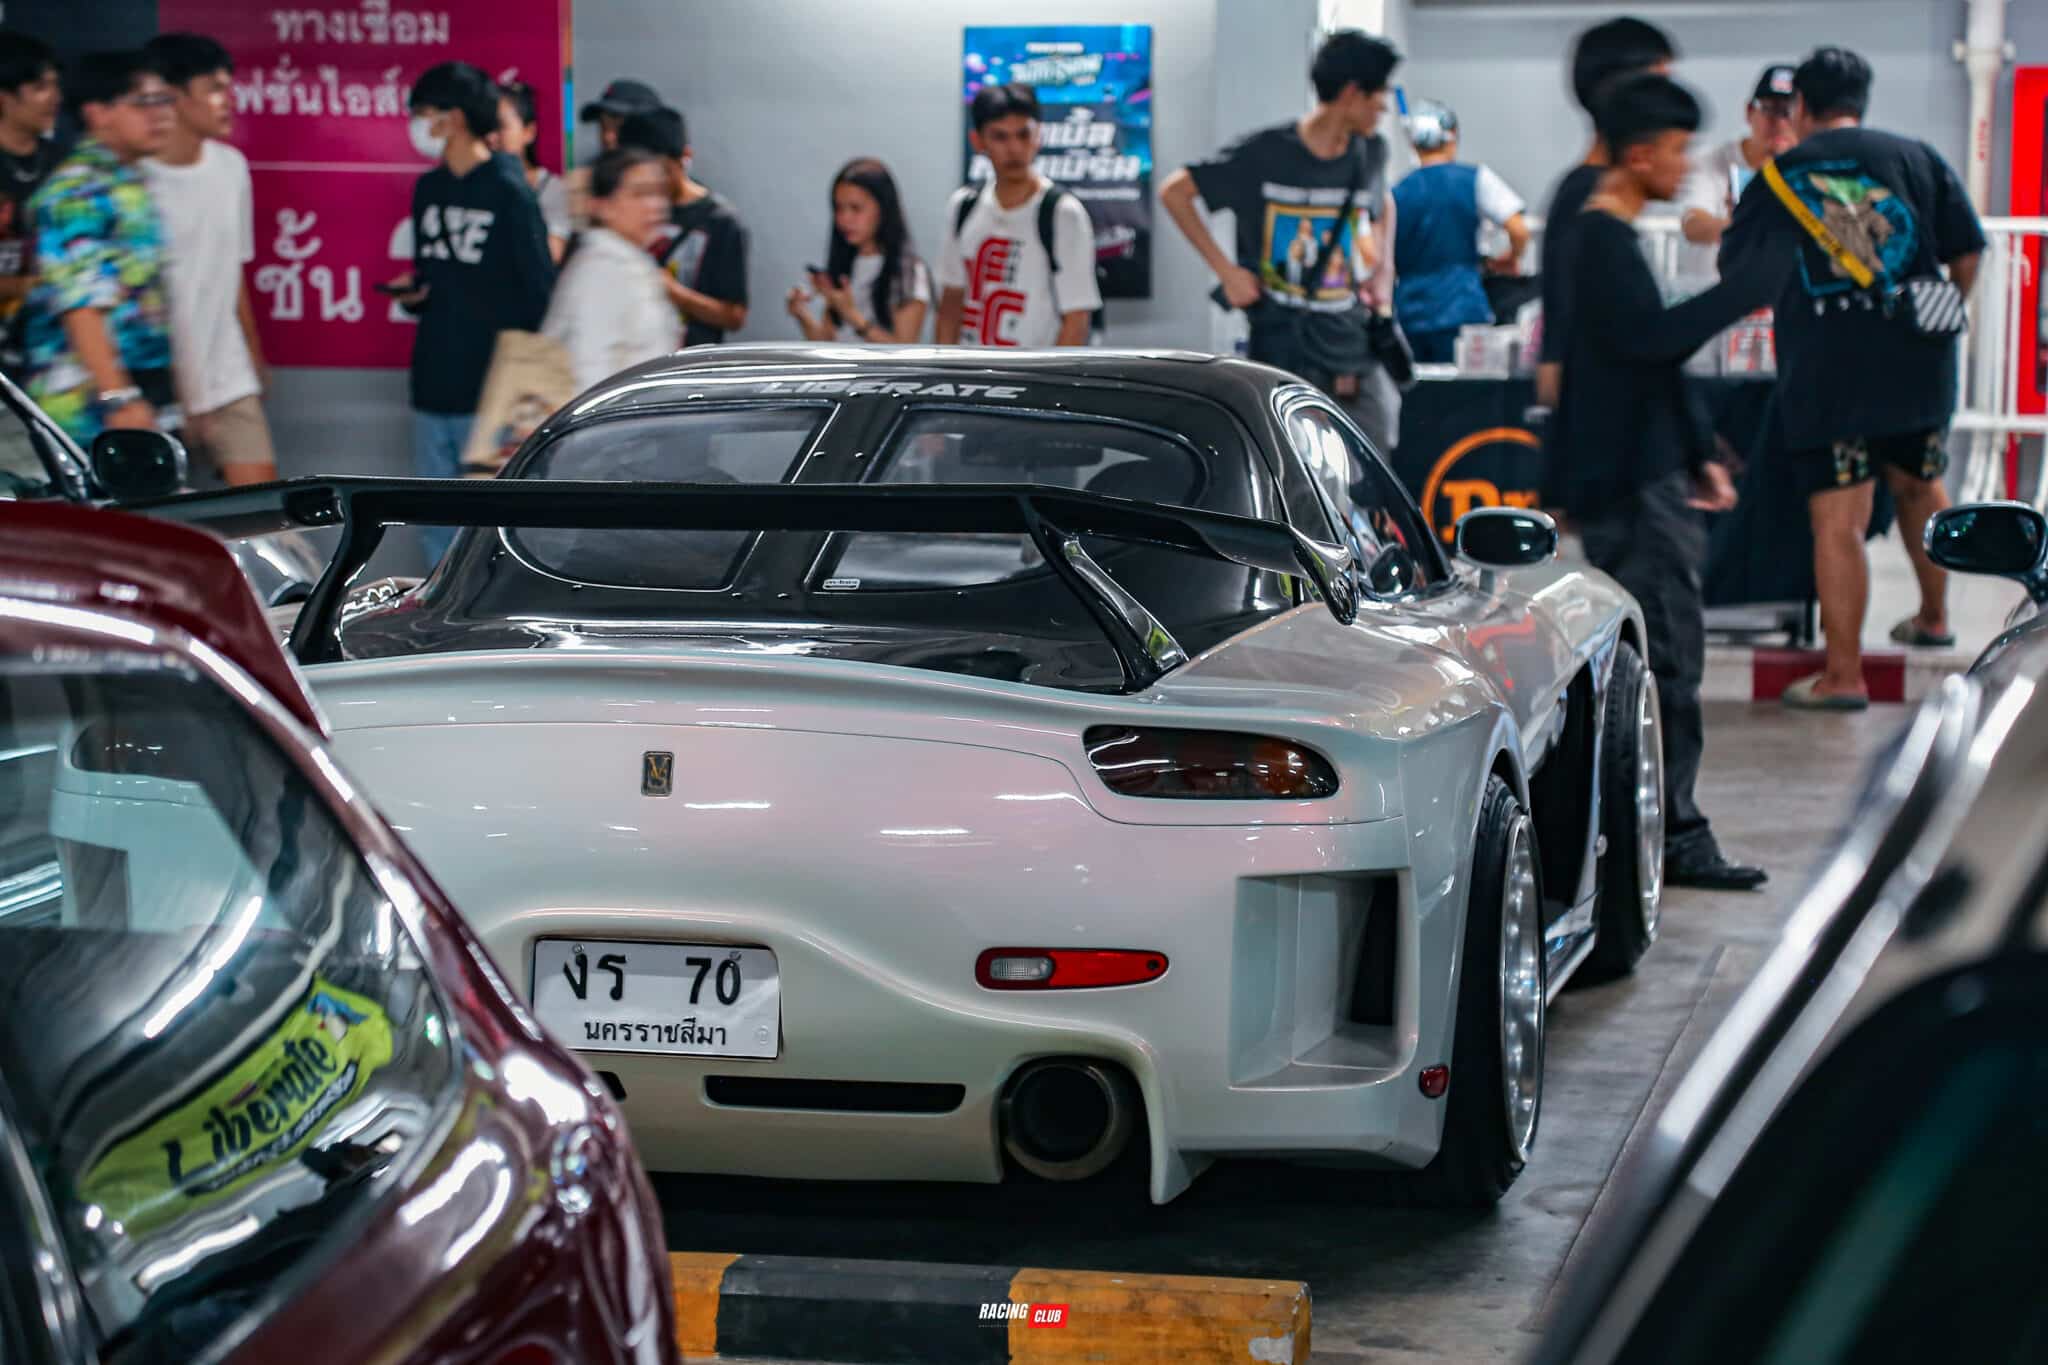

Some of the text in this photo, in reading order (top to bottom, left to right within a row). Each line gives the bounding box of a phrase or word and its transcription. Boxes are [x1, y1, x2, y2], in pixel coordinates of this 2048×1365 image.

[759, 381, 1027, 399] LIBERATE
[686, 956, 742, 1006] 70
[583, 1017, 727, 1046] นครราชสีมา
